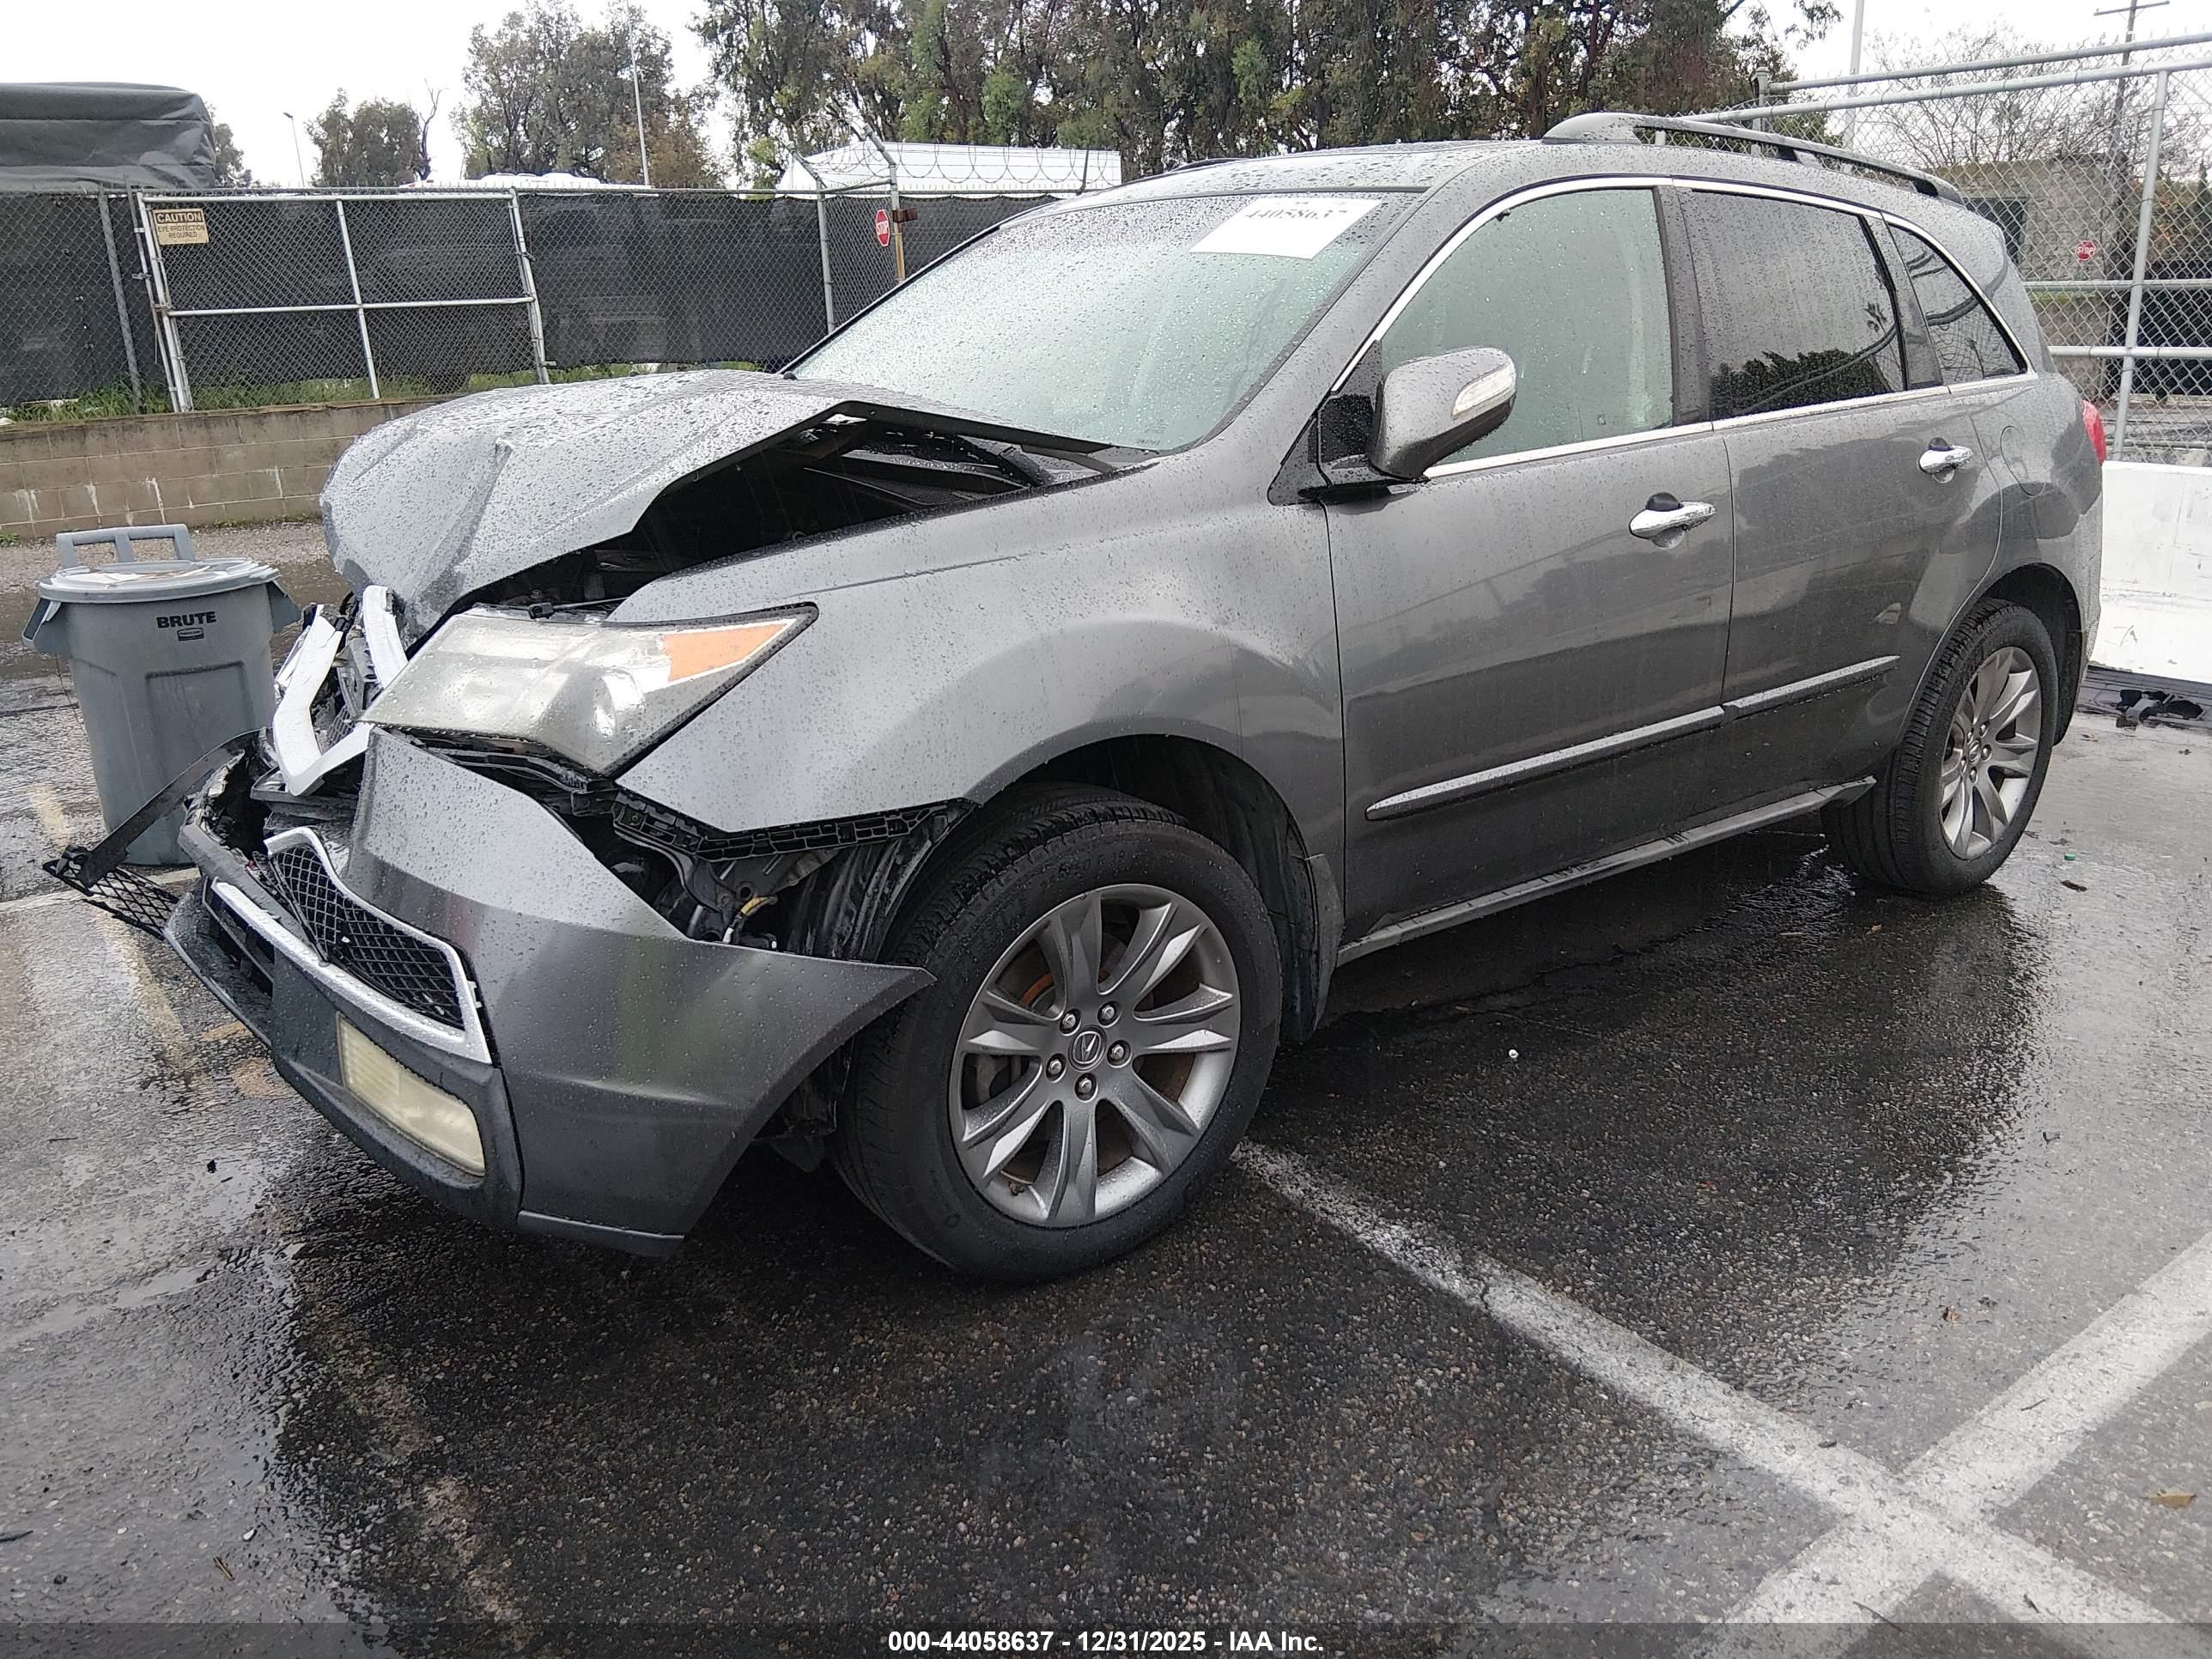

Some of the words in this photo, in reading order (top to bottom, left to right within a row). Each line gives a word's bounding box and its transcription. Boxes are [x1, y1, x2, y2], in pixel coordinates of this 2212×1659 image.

[156, 212, 202, 223] CAUTION
[876, 221, 890, 235] STOP
[2076, 246, 2094, 255] STOP
[156, 611, 217, 629] BRUTE
